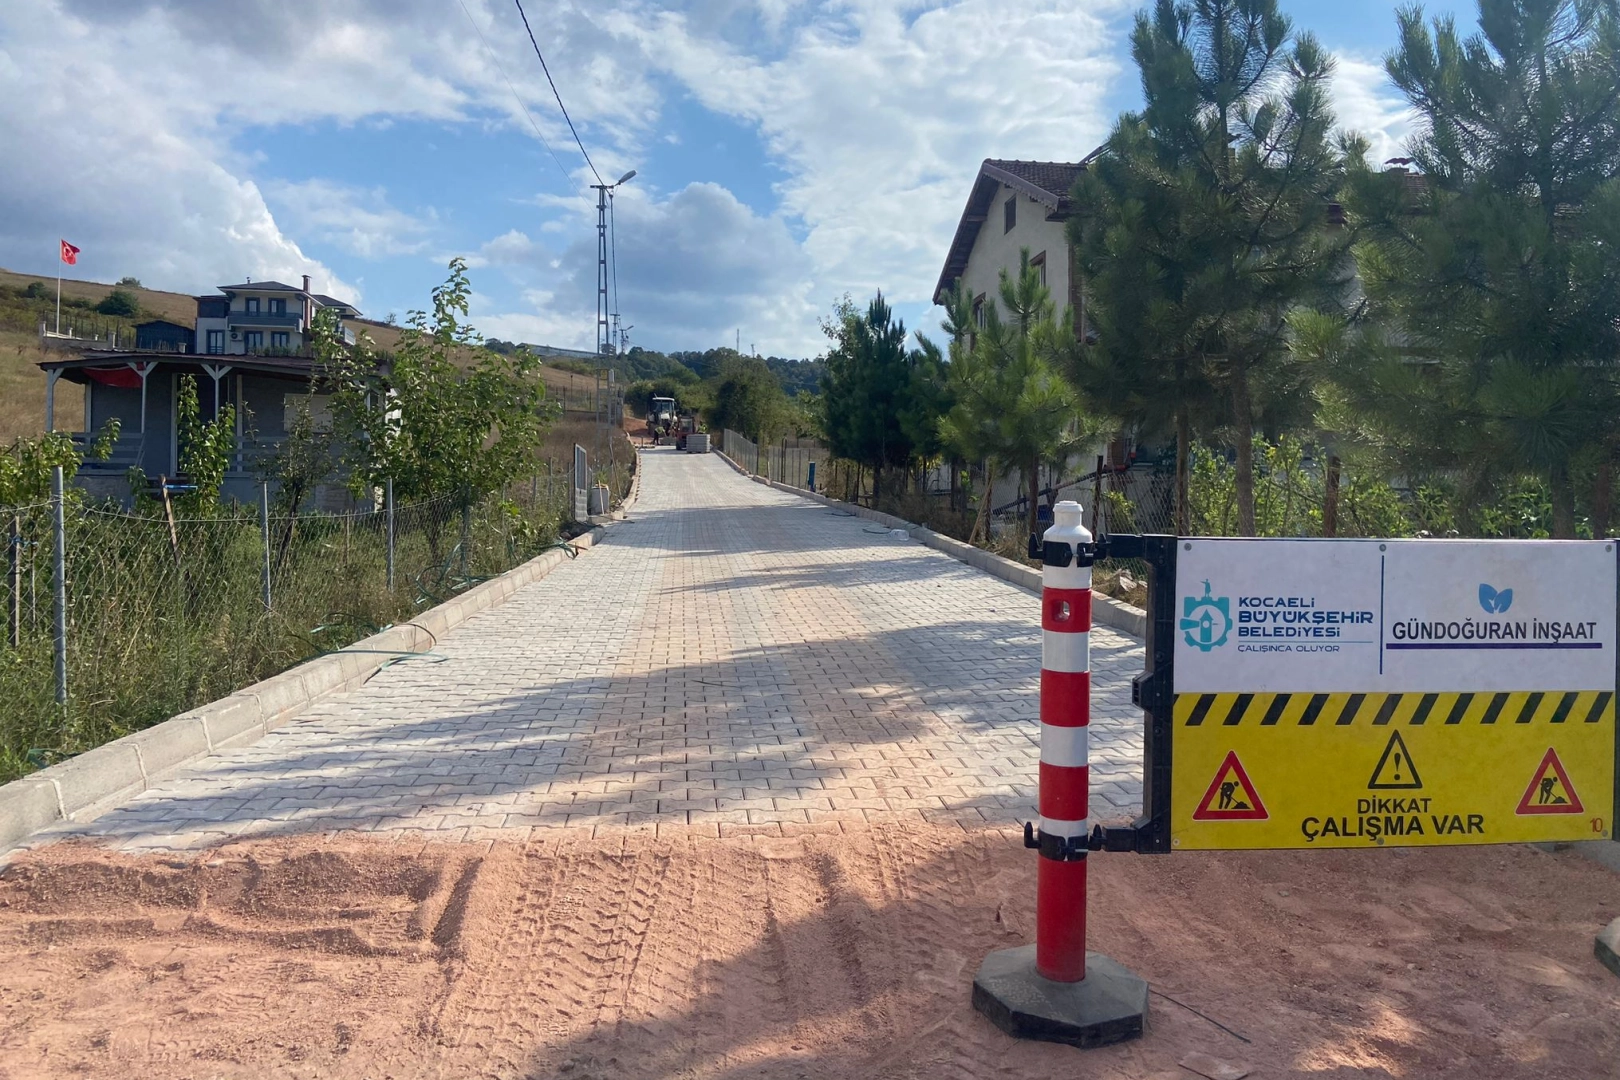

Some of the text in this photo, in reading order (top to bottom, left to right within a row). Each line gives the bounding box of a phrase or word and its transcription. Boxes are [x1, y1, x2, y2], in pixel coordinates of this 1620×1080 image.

[1238, 610, 1374, 625] BÜYÜKŞEHİR
[1392, 618, 1597, 644] GÜNDOĞURAN İNŞAAT
[1238, 644, 1292, 653] ÇALIŞINCA
[1357, 795, 1432, 814] DİKKAT
[1301, 814, 1485, 842] ÇALIŞMA VAR
[1589, 817, 1603, 832] 10
